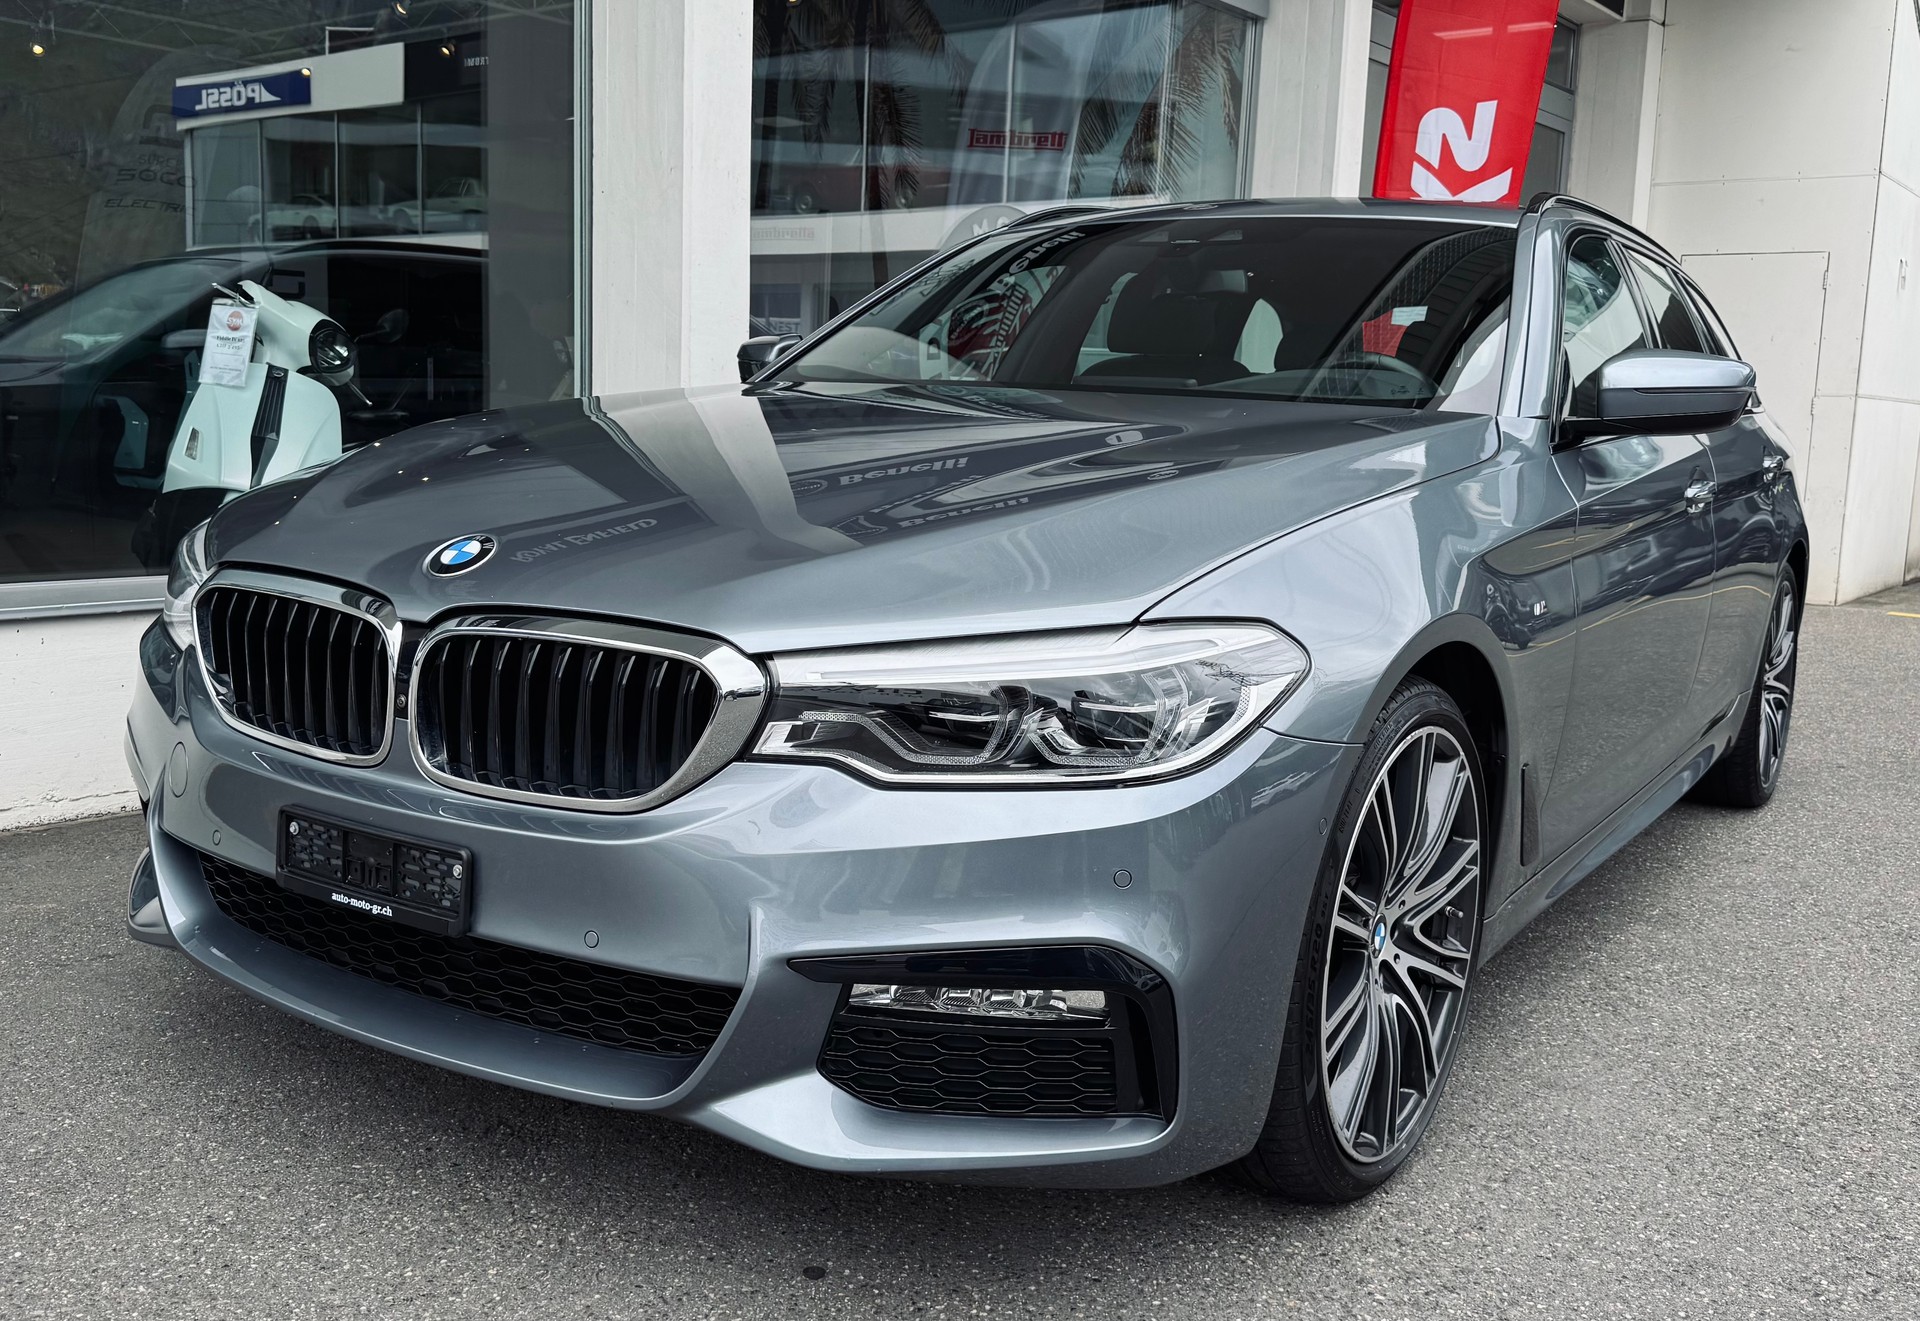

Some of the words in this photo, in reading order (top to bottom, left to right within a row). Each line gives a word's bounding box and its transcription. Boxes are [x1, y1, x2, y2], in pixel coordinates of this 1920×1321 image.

[967, 127, 1068, 151] Lambrett
[104, 198, 194, 214] ELECTRI
[331, 891, 393, 917] auto-moto-gr.ch
